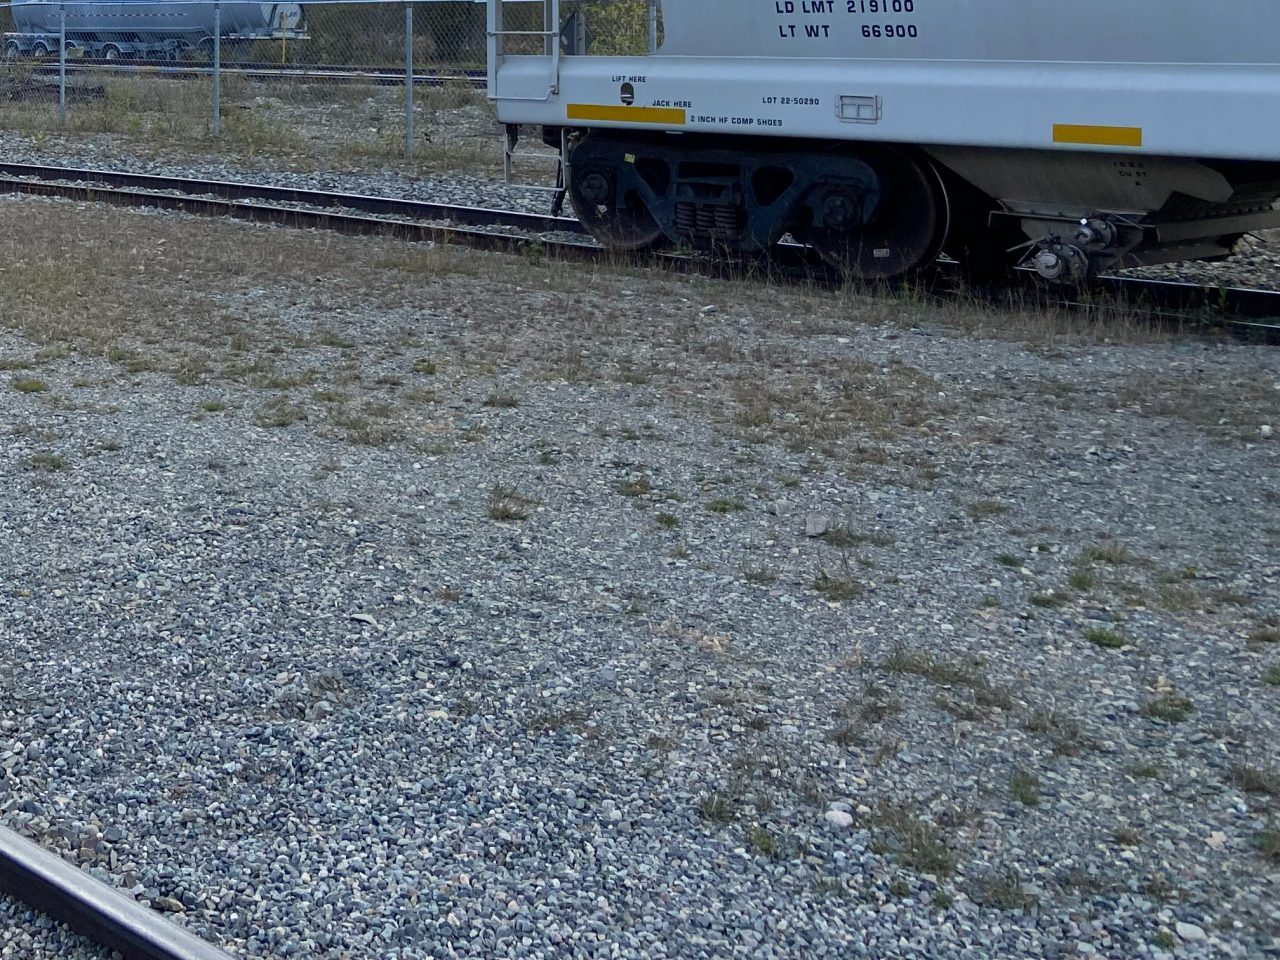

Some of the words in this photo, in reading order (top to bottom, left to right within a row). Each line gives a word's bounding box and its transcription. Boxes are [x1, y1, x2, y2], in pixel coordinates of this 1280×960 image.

[775, 0, 795, 14] LD
[801, 0, 835, 14] LMT
[846, 0, 915, 14] 219100
[778, 25, 796, 38] LT
[804, 25, 831, 38] WT
[861, 24, 919, 38] 66900
[673, 100, 692, 108] HERE
[762, 96, 777, 104] LOT
[718, 116, 729, 124] HF
[731, 117, 754, 125] COMP
[756, 118, 783, 127] SHOES
